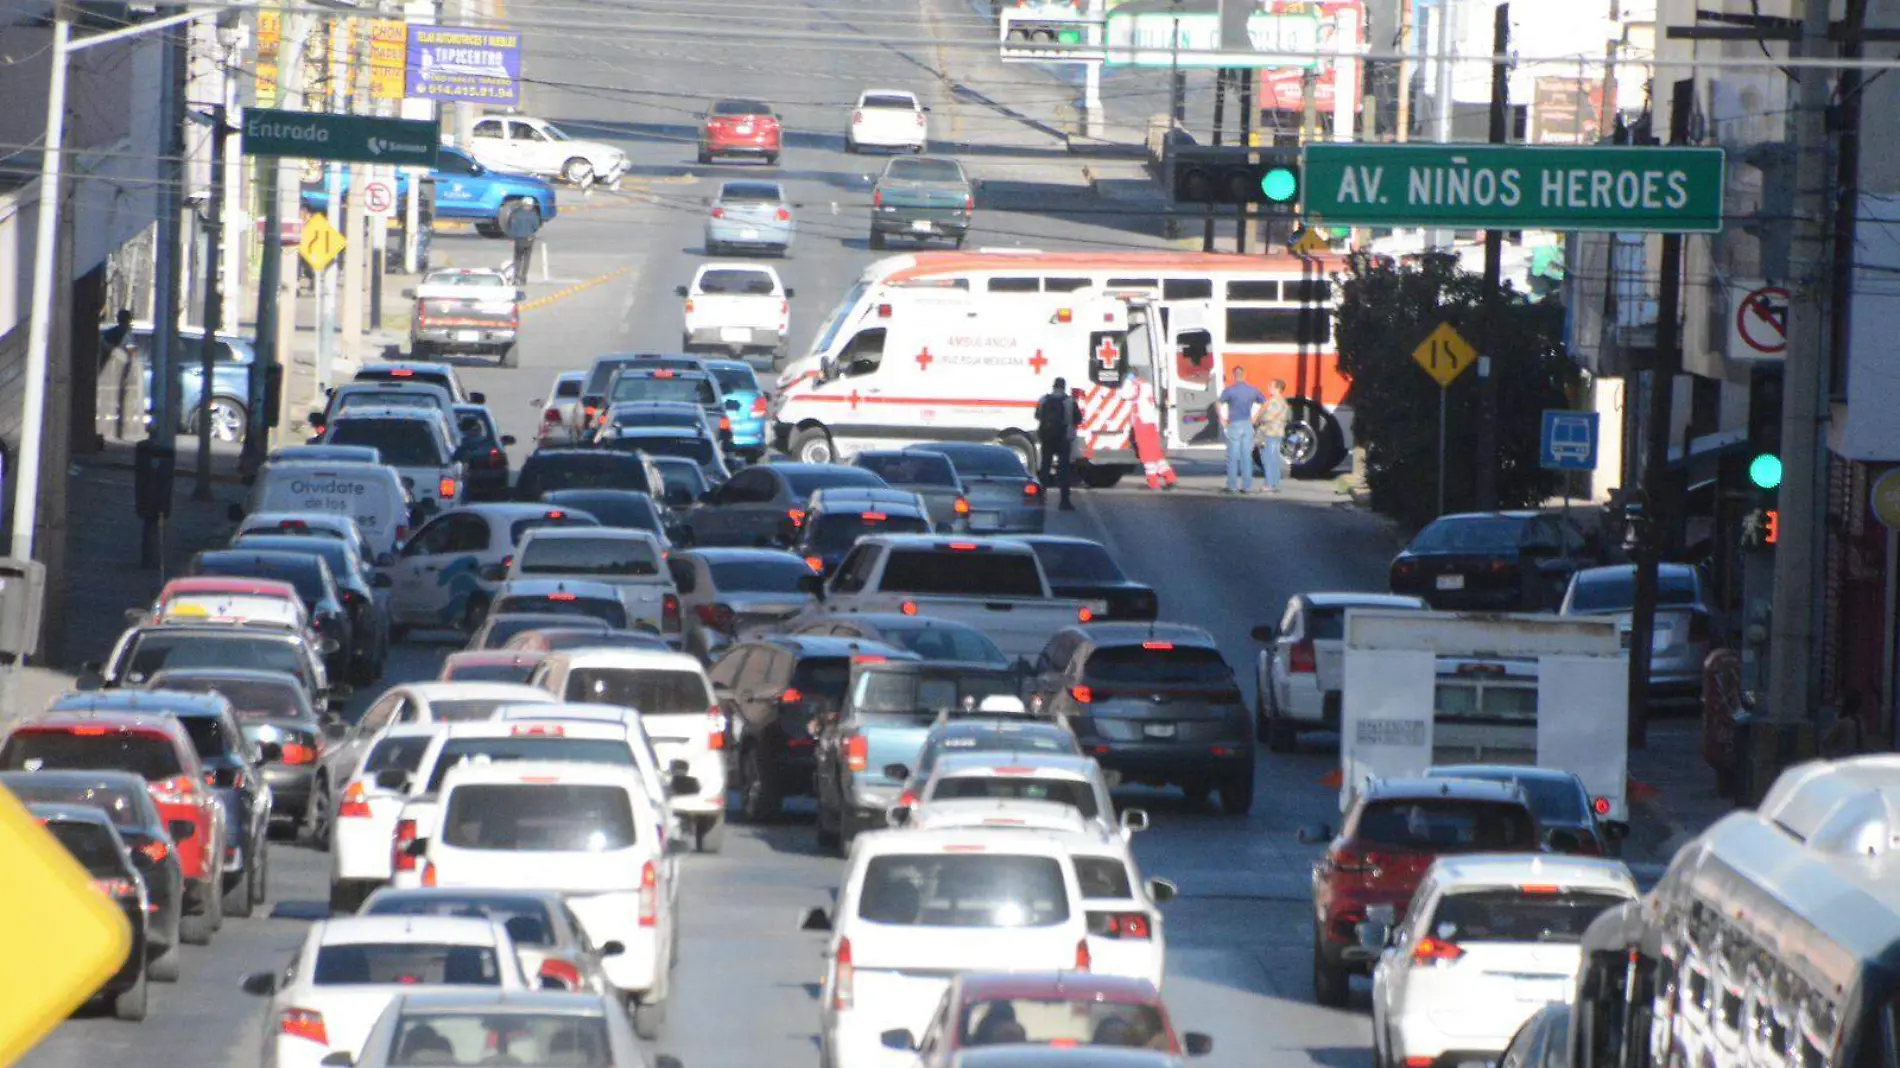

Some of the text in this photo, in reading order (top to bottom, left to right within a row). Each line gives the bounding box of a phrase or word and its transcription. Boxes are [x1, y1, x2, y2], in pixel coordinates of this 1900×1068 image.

[248, 120, 329, 142] Entrada
[1337, 156, 1688, 209] AV. NIÑOS HEROES
[948, 335, 1017, 348] AMBULANCIA
[290, 479, 365, 495] Olvidate
[326, 497, 348, 510] los
